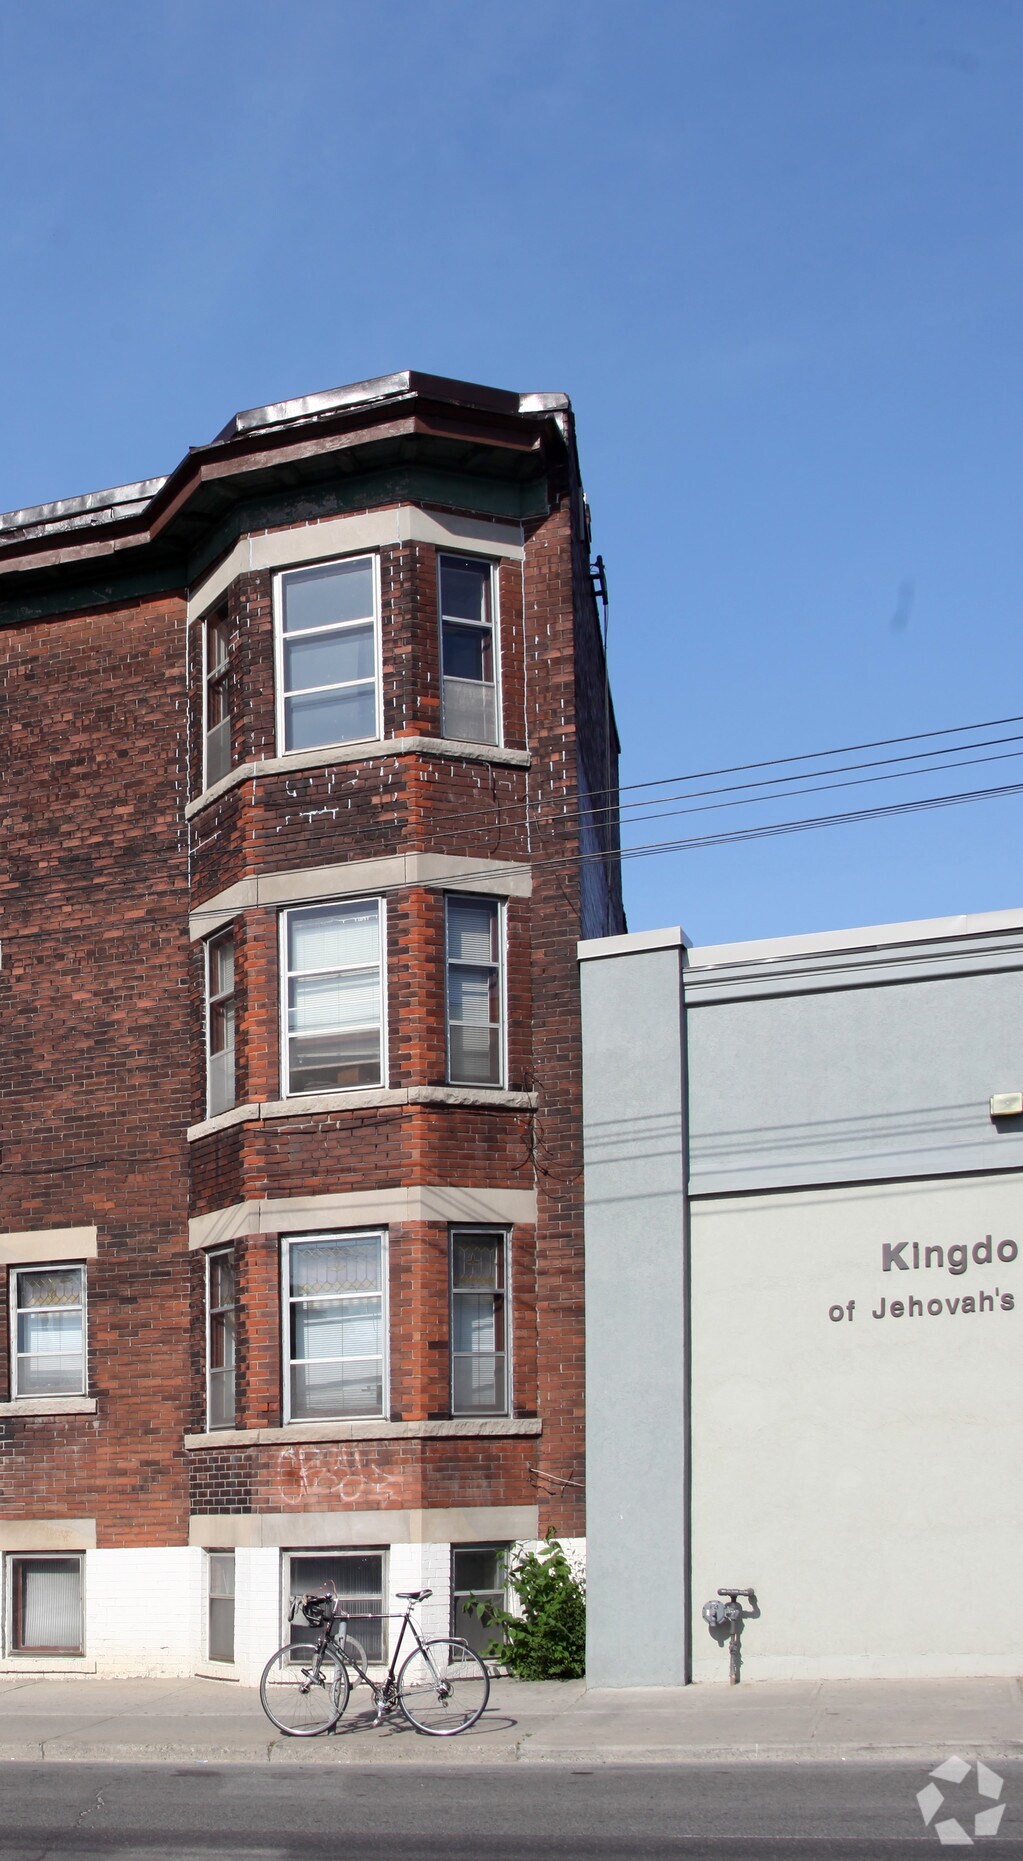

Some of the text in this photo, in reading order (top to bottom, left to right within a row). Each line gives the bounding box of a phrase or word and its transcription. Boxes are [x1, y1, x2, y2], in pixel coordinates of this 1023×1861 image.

[882, 1234, 1018, 1275] Kingdo
[828, 1287, 1016, 1322] of Jehovah's
